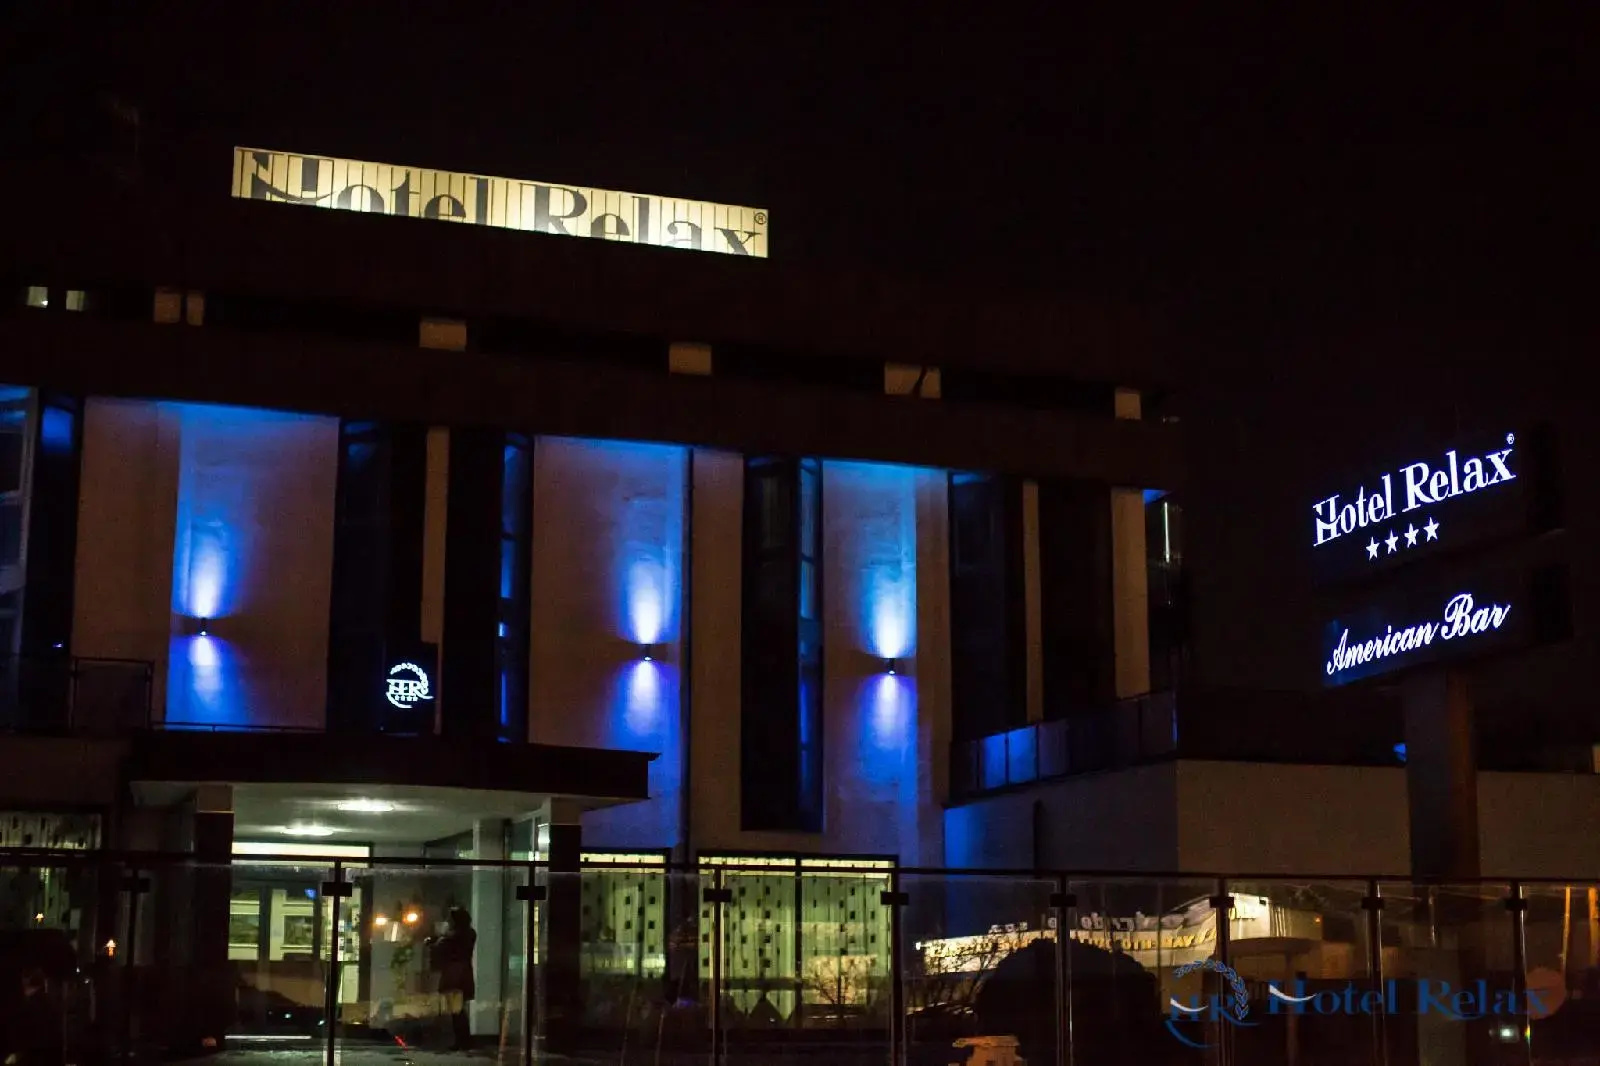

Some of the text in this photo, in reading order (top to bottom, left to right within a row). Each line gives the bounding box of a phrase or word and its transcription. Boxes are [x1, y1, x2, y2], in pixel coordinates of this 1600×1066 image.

[1312, 473, 1396, 547] Hotel
[1326, 592, 1511, 675] American Bar
